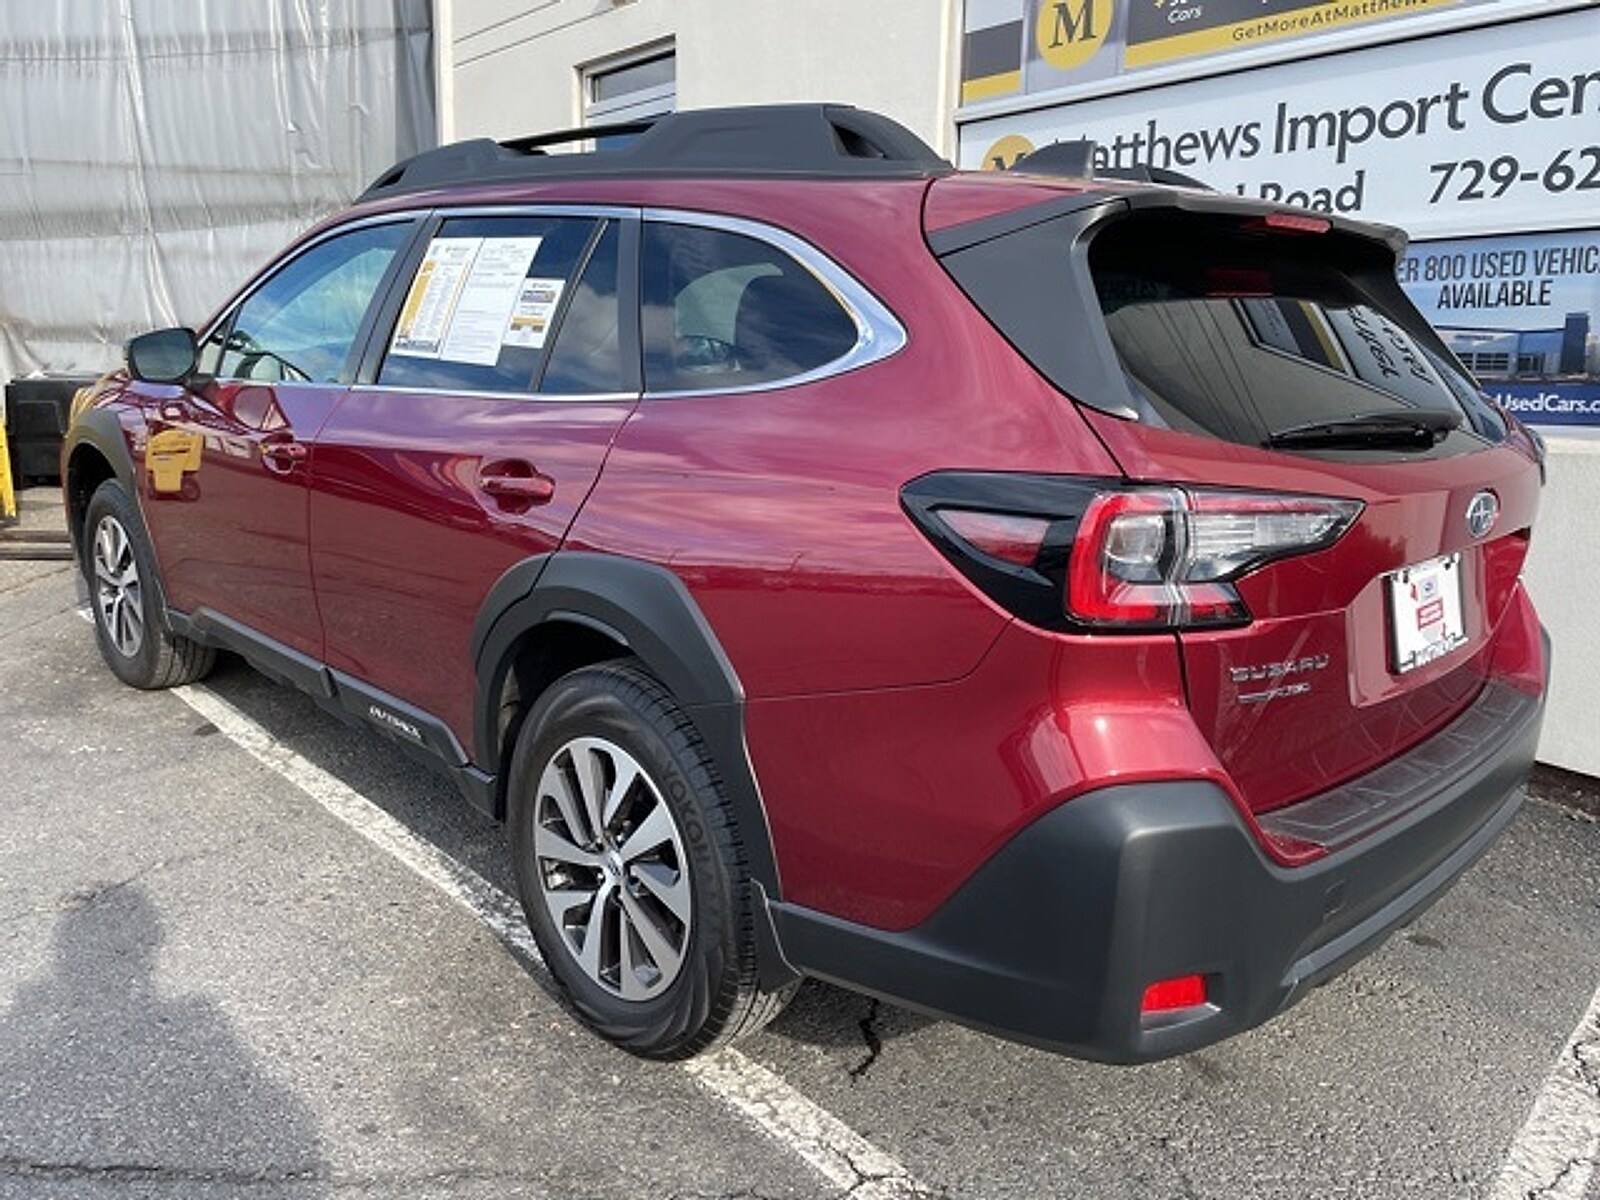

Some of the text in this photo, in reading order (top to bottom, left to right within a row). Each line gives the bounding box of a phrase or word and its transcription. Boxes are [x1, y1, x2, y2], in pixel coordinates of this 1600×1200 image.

[1048, 0, 1097, 49] M
[1167, 6, 1202, 23] Cars
[1232, 0, 1428, 41] GetMoreAtMatthe
[1056, 120, 1261, 169] atthews
[1274, 81, 1469, 163] Import
[1429, 146, 1600, 204] 729-62
[1425, 254, 1466, 281] 800
[1471, 249, 1527, 279] USED
[1437, 279, 1554, 309] AVAILABLE
